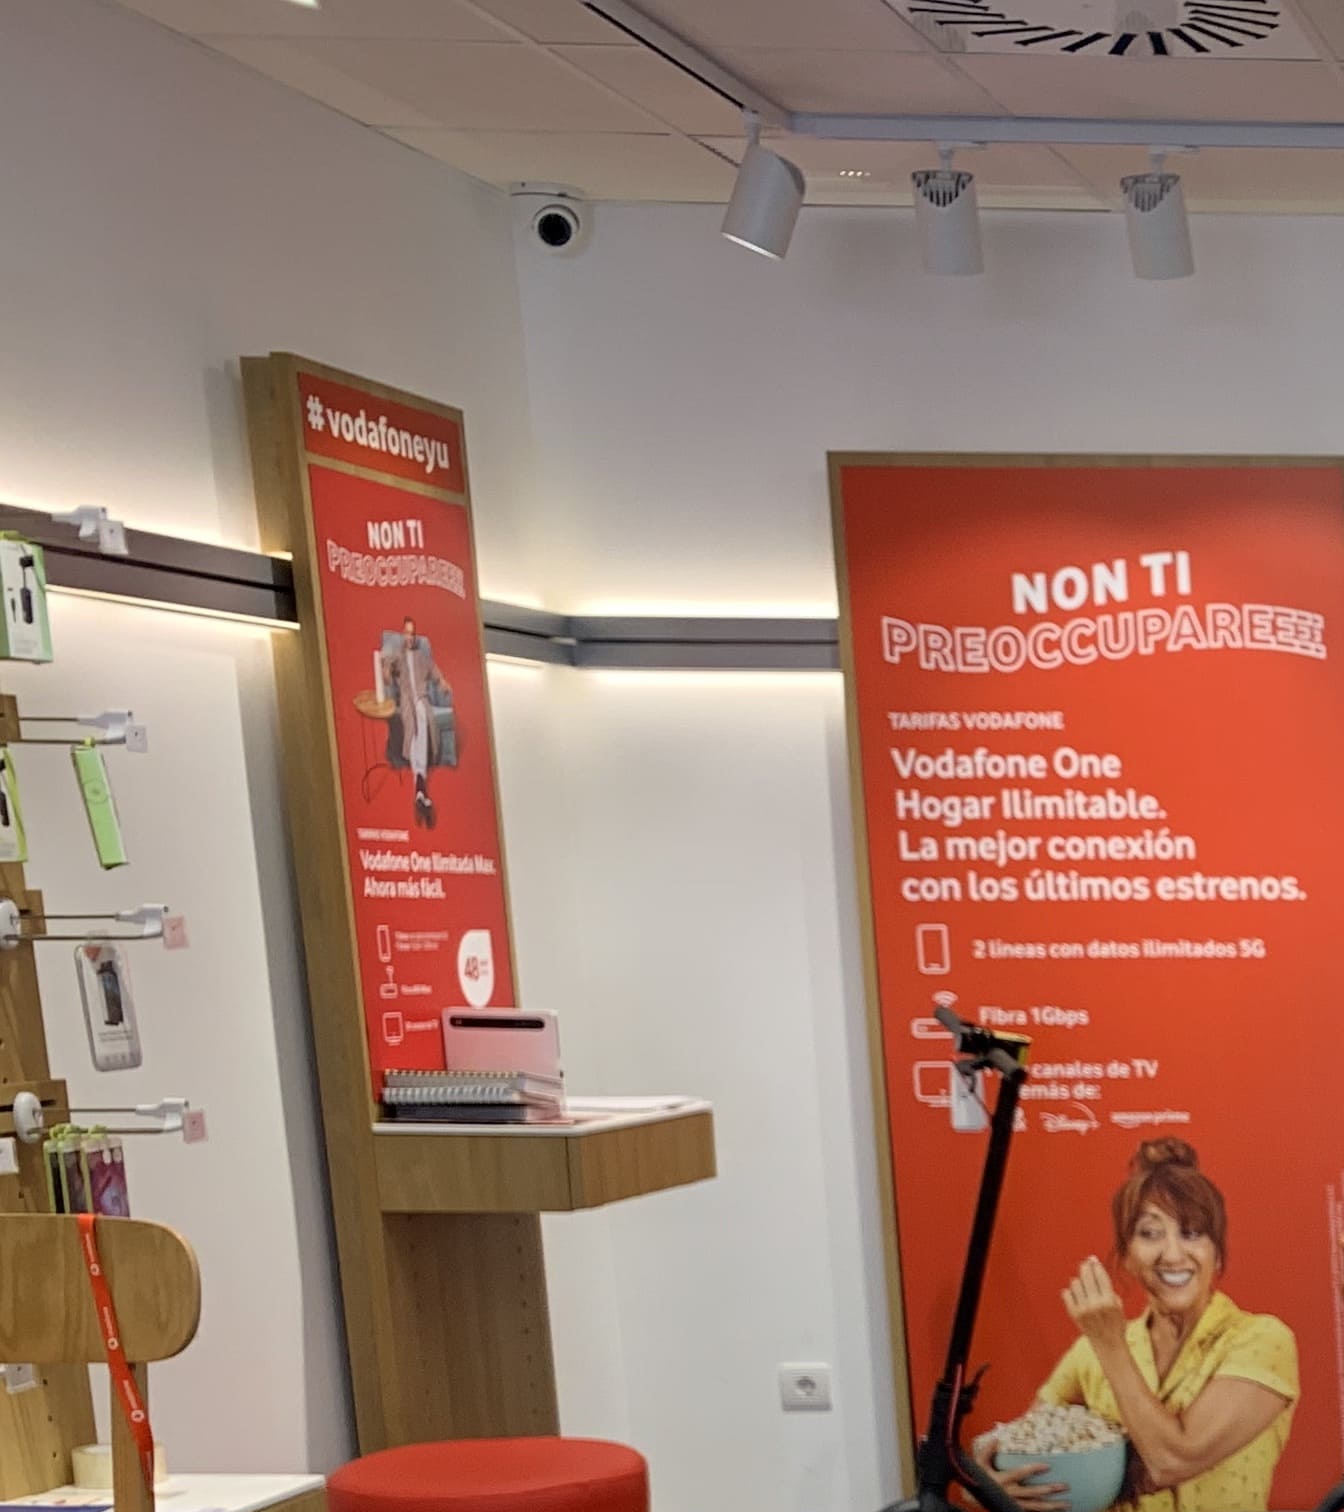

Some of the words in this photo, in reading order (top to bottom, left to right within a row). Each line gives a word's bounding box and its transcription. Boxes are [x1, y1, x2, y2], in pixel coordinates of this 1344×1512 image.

[306, 394, 450, 475] #vodafoneyu
[367, 520, 405, 550] NON
[406, 519, 424, 549] TI
[1011, 558, 1129, 614] NON
[1140, 550, 1192, 597] TI
[888, 711, 960, 731] TARIFAS
[962, 711, 1065, 731] VODAFONE
[890, 747, 1047, 779] Vodafone
[1052, 747, 1122, 779] One
[896, 790, 994, 827] Hogar
[1002, 788, 1167, 821] Ilimitable.
[359, 849, 410, 872] Vodafone
[410, 851, 431, 872] One
[899, 830, 939, 862] La
[946, 832, 1041, 868] mejor
[1047, 827, 1196, 860] conexión
[364, 876, 397, 898] Ahora
[398, 876, 420, 898] más
[902, 877, 961, 902] con
[968, 871, 1018, 902] los
[1025, 869, 1150, 902] últimos
[1156, 874, 1306, 902] estrenos.
[972, 940, 986, 959] 2
[989, 939, 1046, 959] líneas
[1049, 943, 1084, 959] con
[1087, 939, 1139, 959] datos
[1142, 938, 1237, 959] ilimitados
[1239, 938, 1266, 959] 5G
[978, 1006, 1028, 1025] Fibra
[1031, 1006, 1090, 1029] 1Gbps
[1031, 1060, 1104, 1078] canales
[1107, 1060, 1131, 1079] de
[1131, 1059, 1160, 1079] TV
[1019, 1082, 1070, 1099] emás
[1073, 1082, 1102, 1099] de:
